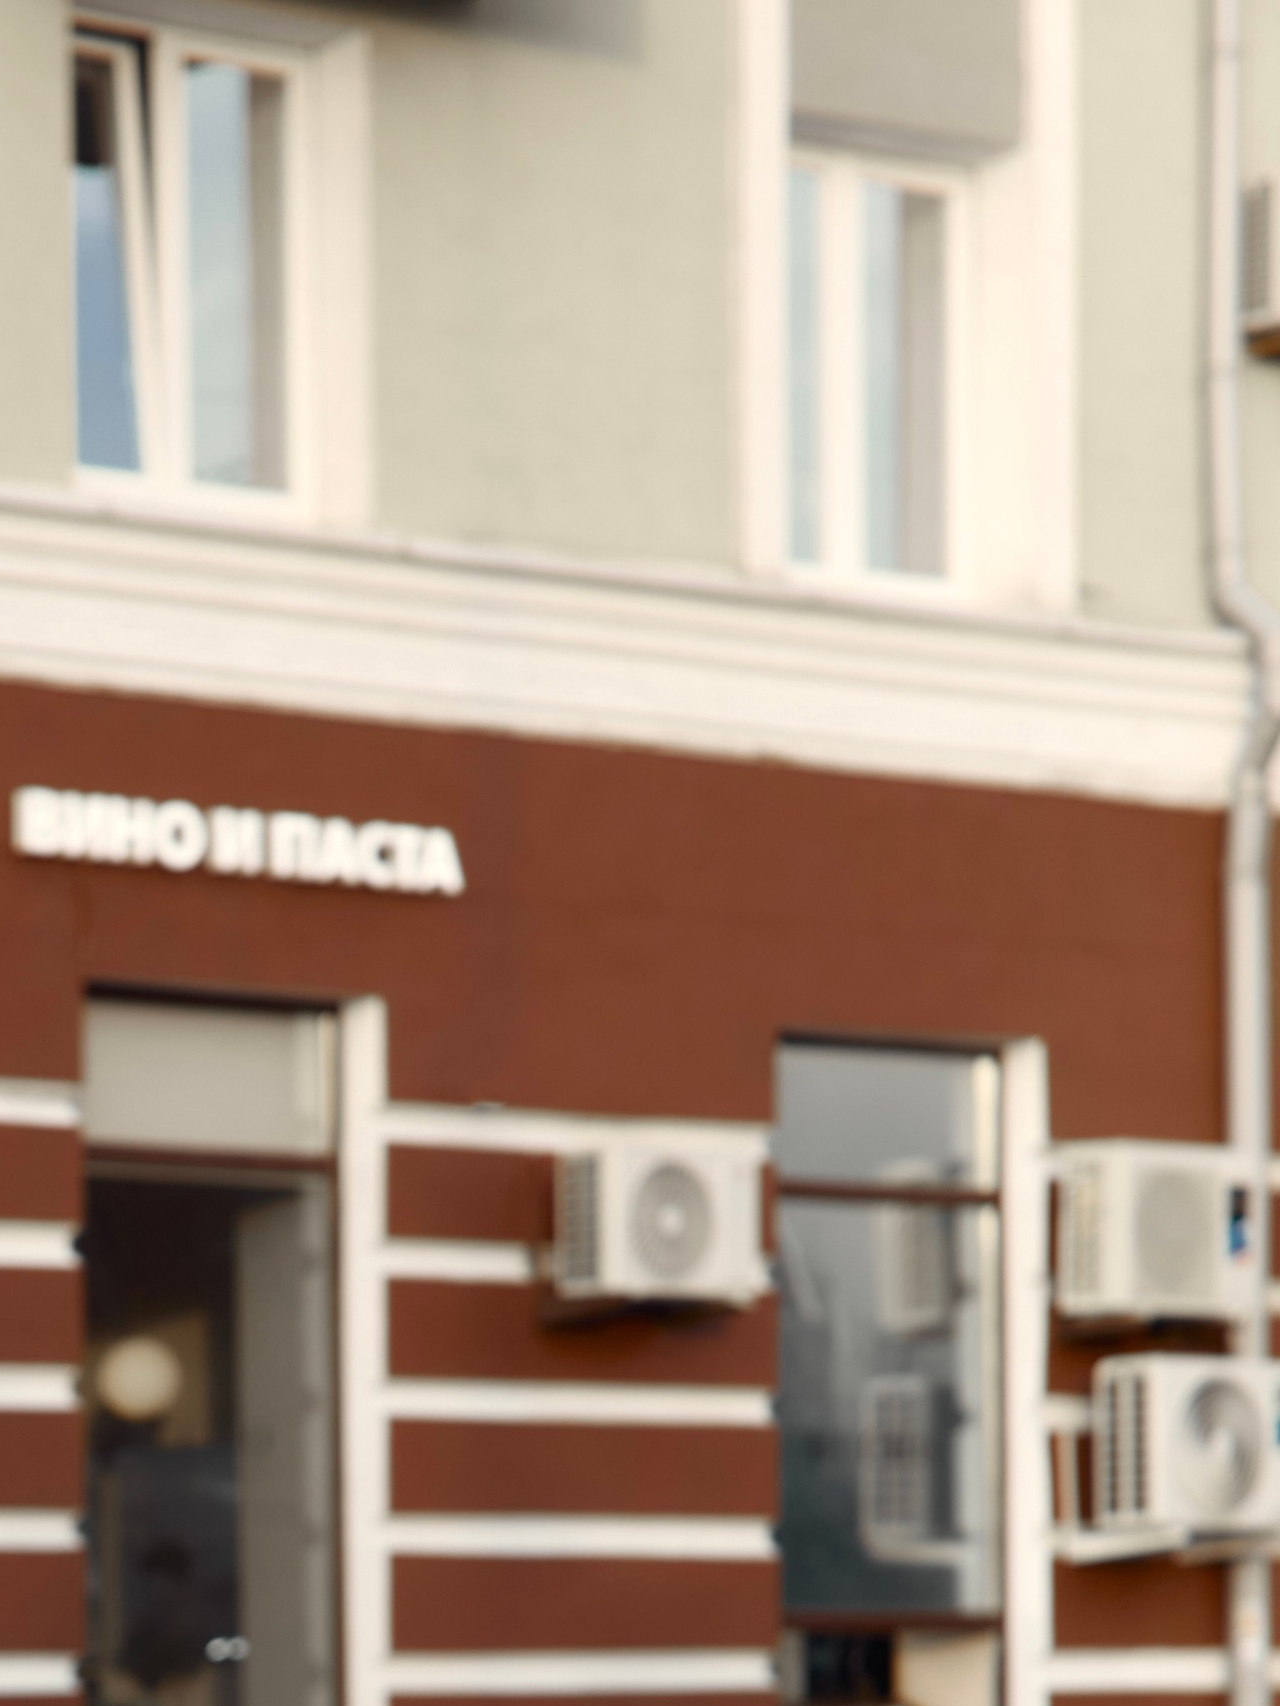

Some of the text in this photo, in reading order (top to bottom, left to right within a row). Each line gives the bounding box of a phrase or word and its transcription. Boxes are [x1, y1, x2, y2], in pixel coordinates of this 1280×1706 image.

[14, 786, 464, 895] ВИНО И ПАСТА
